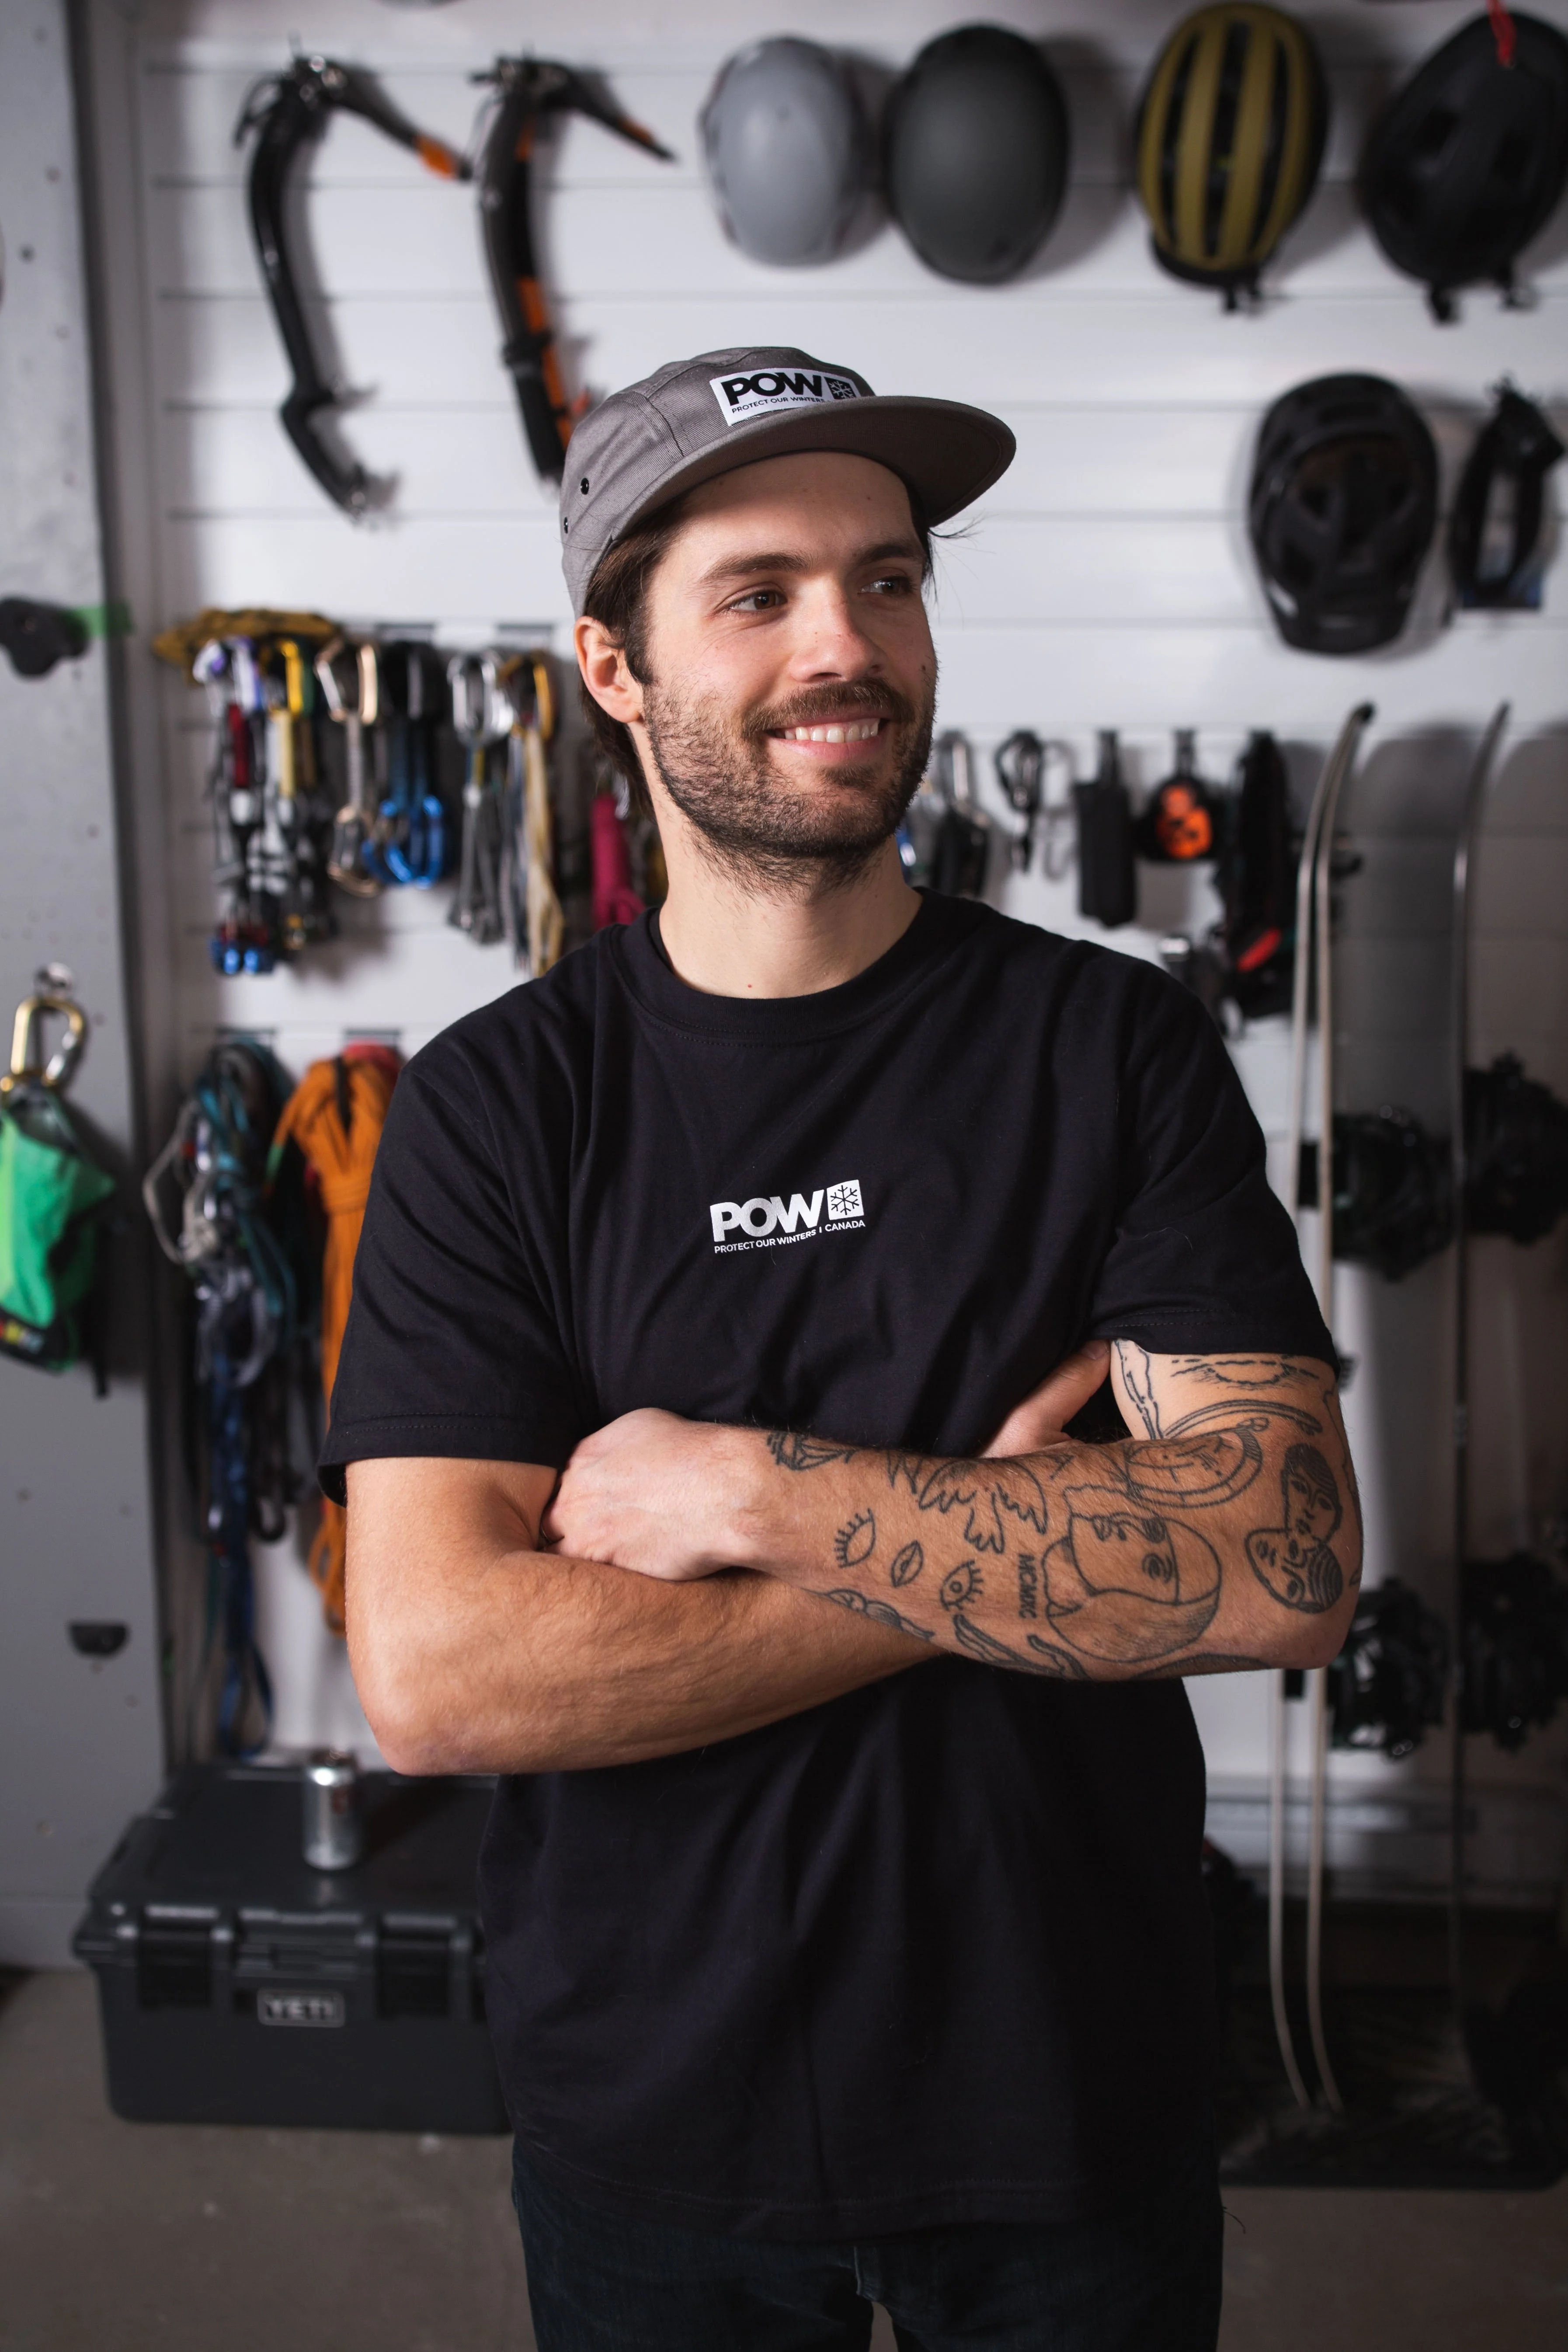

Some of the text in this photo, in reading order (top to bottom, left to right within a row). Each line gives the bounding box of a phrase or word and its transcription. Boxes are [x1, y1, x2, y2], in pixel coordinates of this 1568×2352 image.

[721, 372, 823, 406] POW
[731, 399, 768, 413] PROTECT
[710, 1189, 824, 1242] POW
[714, 1241, 755, 1254] PROTECT
[756, 1238, 775, 1247] OUR
[776, 1229, 816, 1245] WINTERS
[824, 1219, 866, 1232] CANADA
[264, 1997, 335, 2019] YETI
